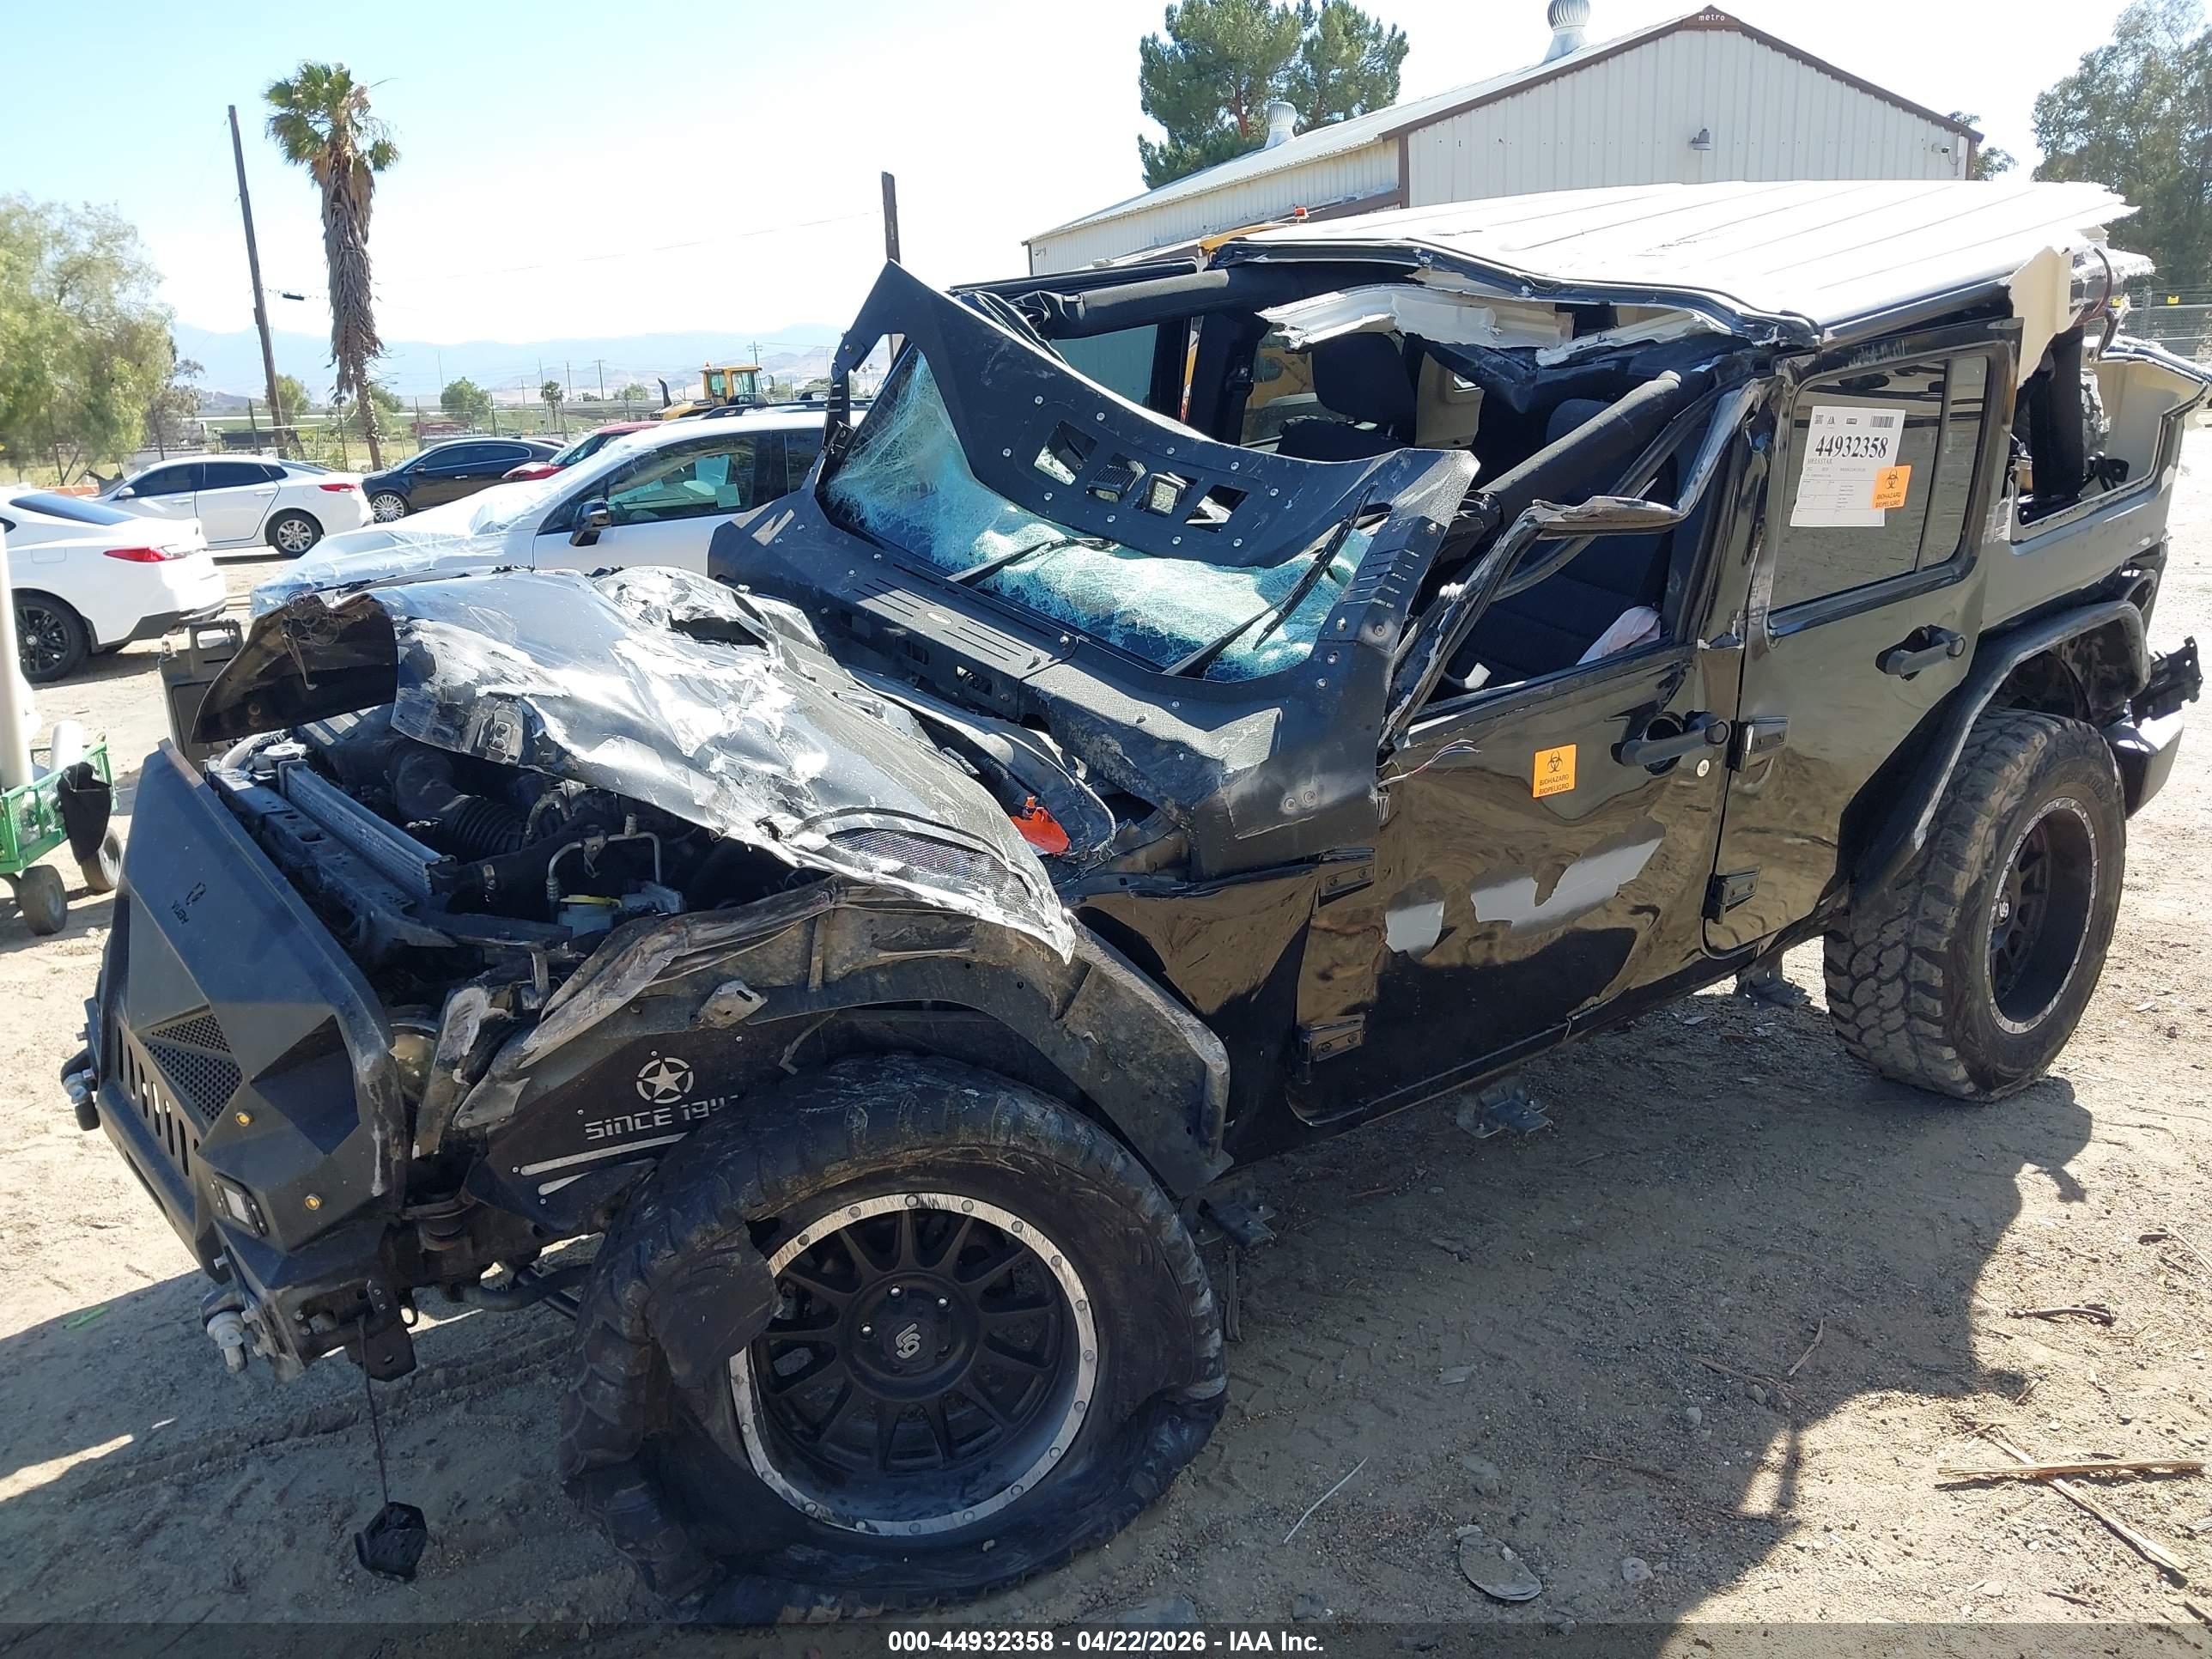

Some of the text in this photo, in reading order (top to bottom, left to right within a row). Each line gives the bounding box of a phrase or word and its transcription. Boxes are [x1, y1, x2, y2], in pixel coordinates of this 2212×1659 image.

[1814, 434, 1888, 459] 44932358
[1876, 491, 1901, 500] BIOHAZARD
[1539, 774, 1570, 787] BIOHAZARD
[1538, 782, 1570, 795] BIOPELIGRO
